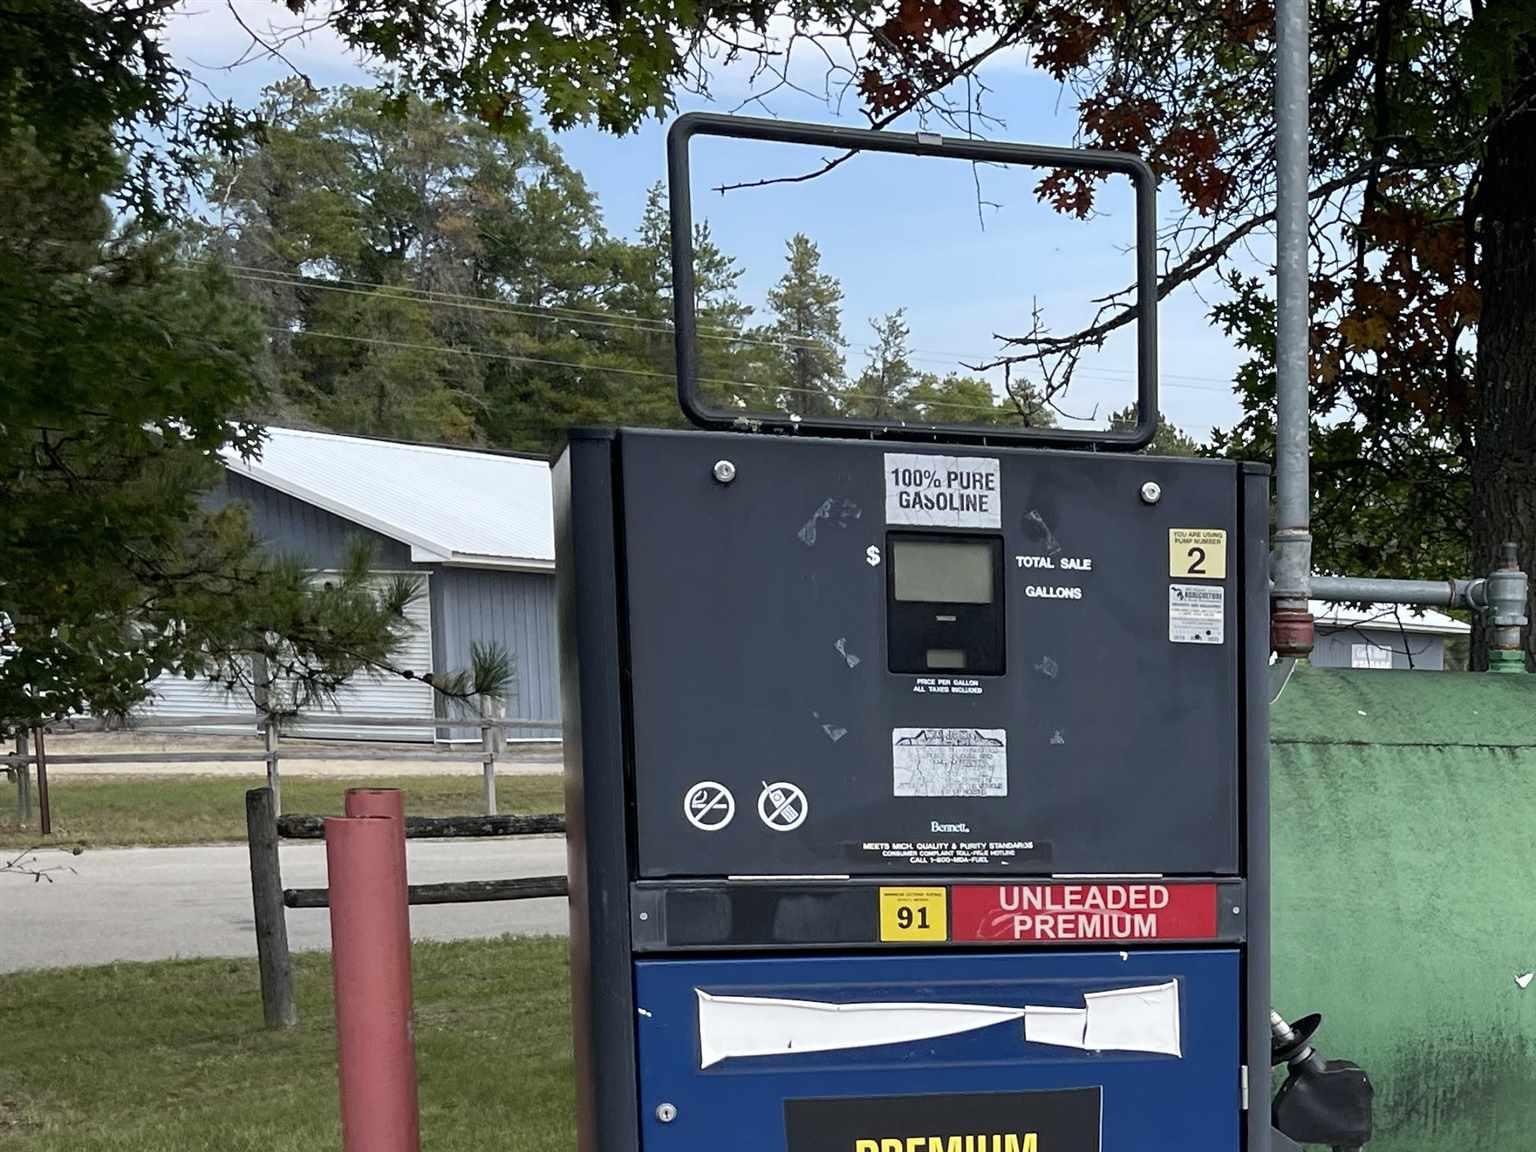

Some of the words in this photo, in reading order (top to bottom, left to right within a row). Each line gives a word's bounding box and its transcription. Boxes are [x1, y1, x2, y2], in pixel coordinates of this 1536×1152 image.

[891, 468, 942, 489] 100%
[947, 471, 995, 491] PURE
[899, 491, 989, 513] GASOLINE
[866, 545, 881, 567] $
[1015, 556, 1055, 569] TOTAL
[1060, 557, 1092, 571] SALE
[1188, 547, 1206, 574] 2
[1025, 585, 1082, 600] GALLONS
[863, 842, 890, 850] MEETS
[916, 842, 949, 850] QUALITY
[960, 842, 987, 850] PURITY
[989, 841, 1034, 849] STANDARDS
[909, 856, 928, 864] CALL
[1000, 885, 1169, 911] UNLEADED
[897, 906, 930, 929] 91
[1012, 913, 1157, 940] PREMIUM
